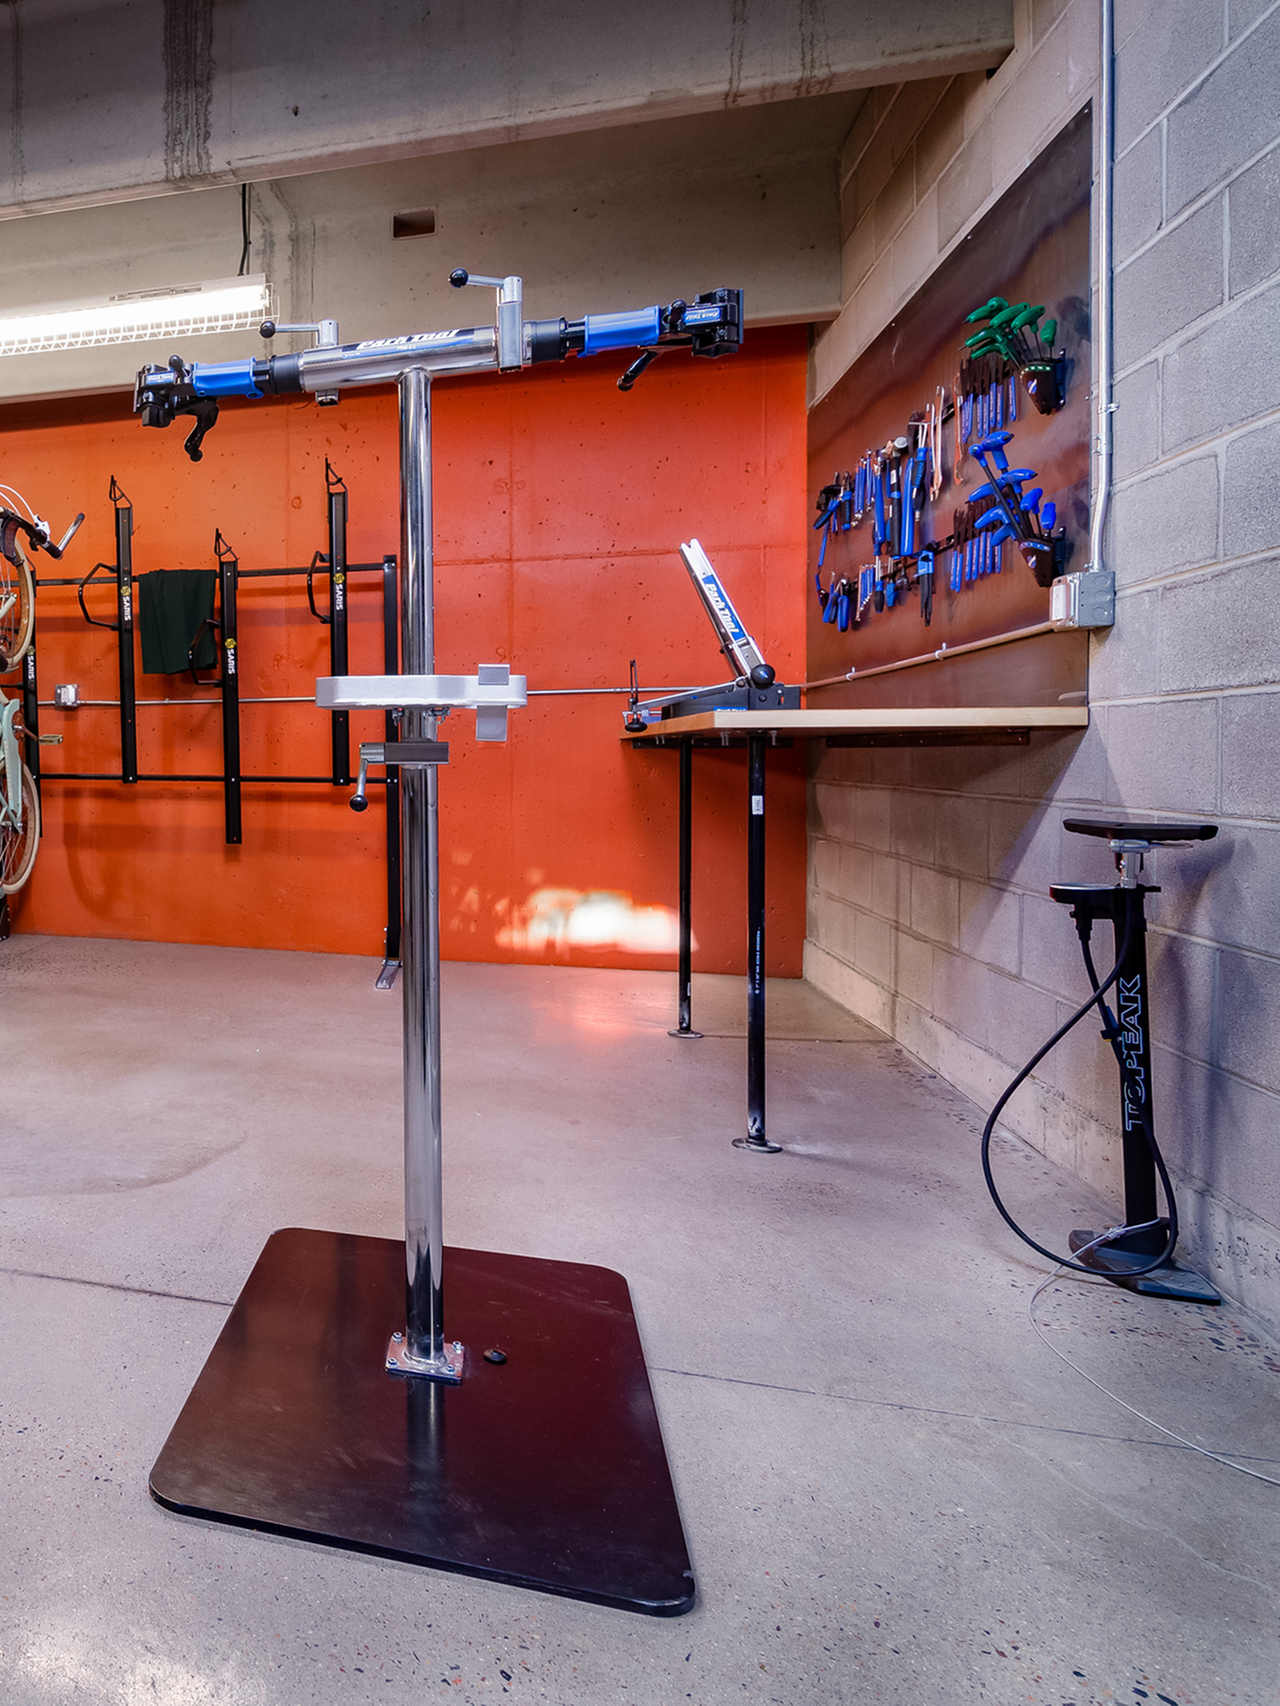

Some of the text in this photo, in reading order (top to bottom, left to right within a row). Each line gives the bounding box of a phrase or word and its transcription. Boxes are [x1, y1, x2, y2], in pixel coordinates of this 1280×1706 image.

[122, 595, 132, 622] SARIS
[335, 583, 344, 611] SARIS
[27, 654, 36, 680] SARIS
[227, 648, 236, 675] SARIS
[1119, 973, 1146, 1132] TOPEAK
